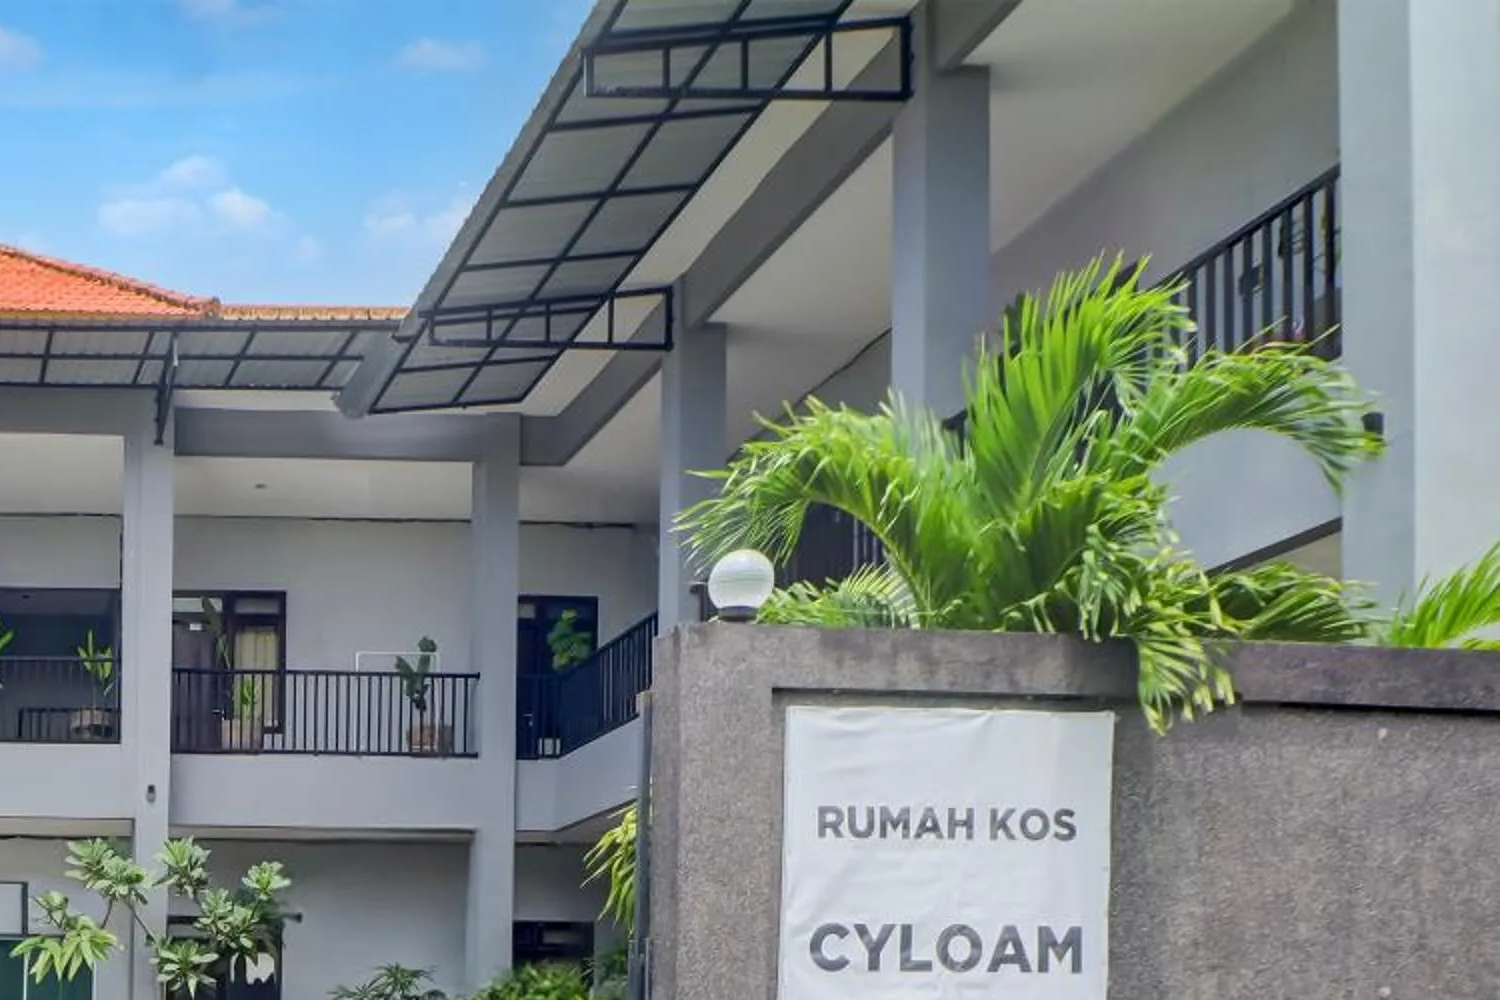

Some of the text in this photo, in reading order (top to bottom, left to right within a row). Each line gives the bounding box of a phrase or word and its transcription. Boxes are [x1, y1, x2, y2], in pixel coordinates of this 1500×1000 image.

[816, 805, 1077, 842] RUMAH KOS
[809, 922, 1083, 974] CYLOAM
